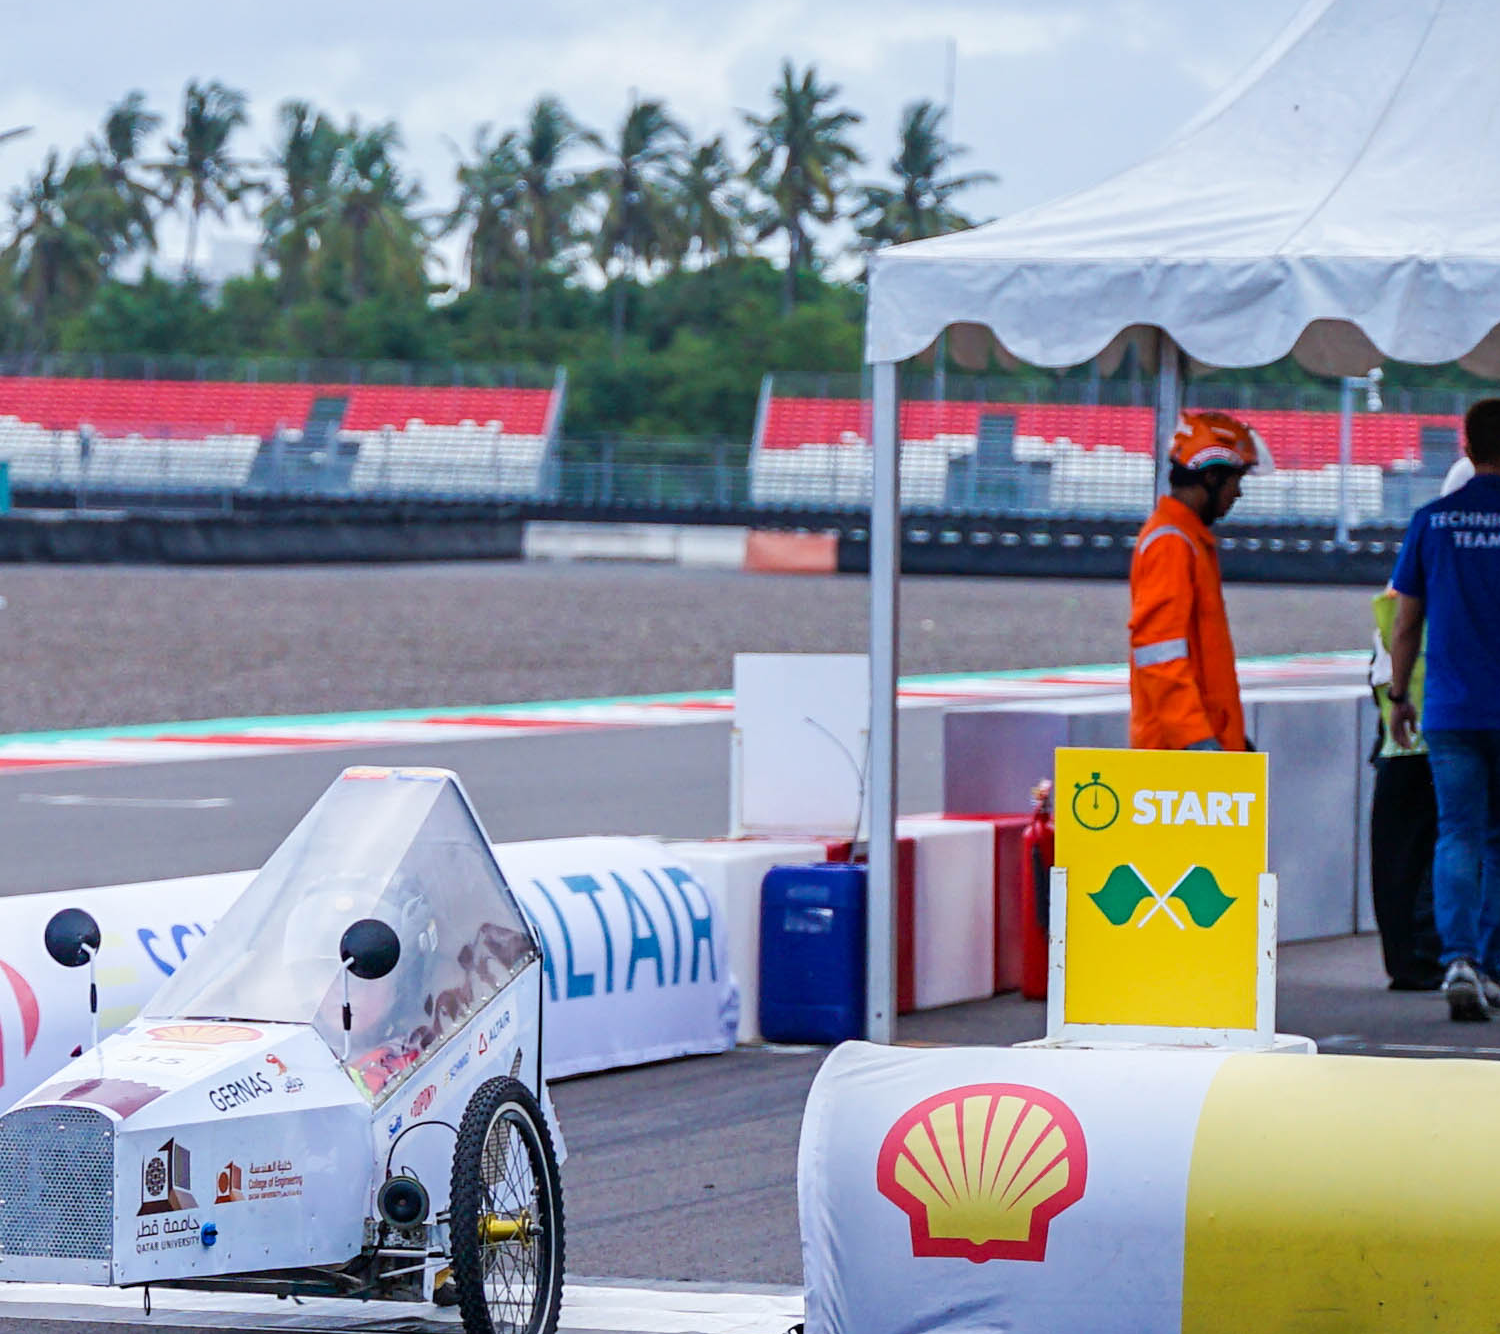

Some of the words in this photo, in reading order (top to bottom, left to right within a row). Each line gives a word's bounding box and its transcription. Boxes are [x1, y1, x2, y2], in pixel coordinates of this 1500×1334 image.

[1132, 789, 1256, 827] START
[209, 1072, 272, 1111] GERNAS
[136, 1218, 159, 1241] قطر
[163, 1214, 200, 1234] جامعة
[136, 1241, 159, 1254] QATAR
[160, 1236, 200, 1251] UNIVERSITY
